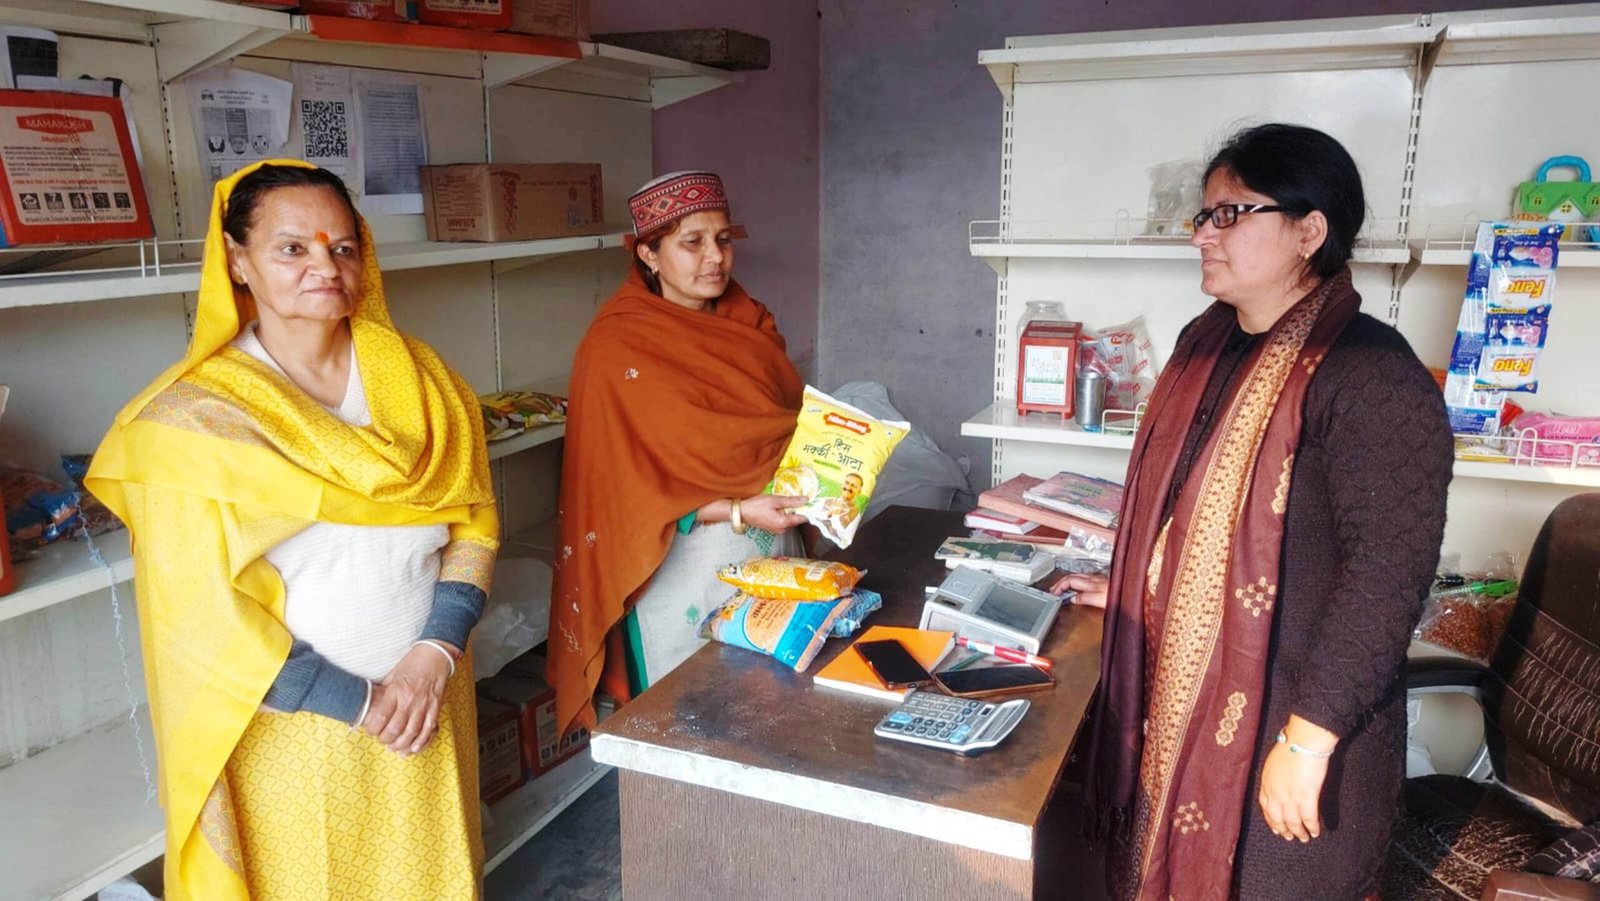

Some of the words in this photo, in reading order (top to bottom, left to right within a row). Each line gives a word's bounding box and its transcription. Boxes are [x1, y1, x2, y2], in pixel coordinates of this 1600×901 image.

[1493, 358, 1534, 377] Fena
[833, 438, 853, 452] हिम
[803, 443, 832, 459] मक्की
[837, 452, 864, 471] आटा
